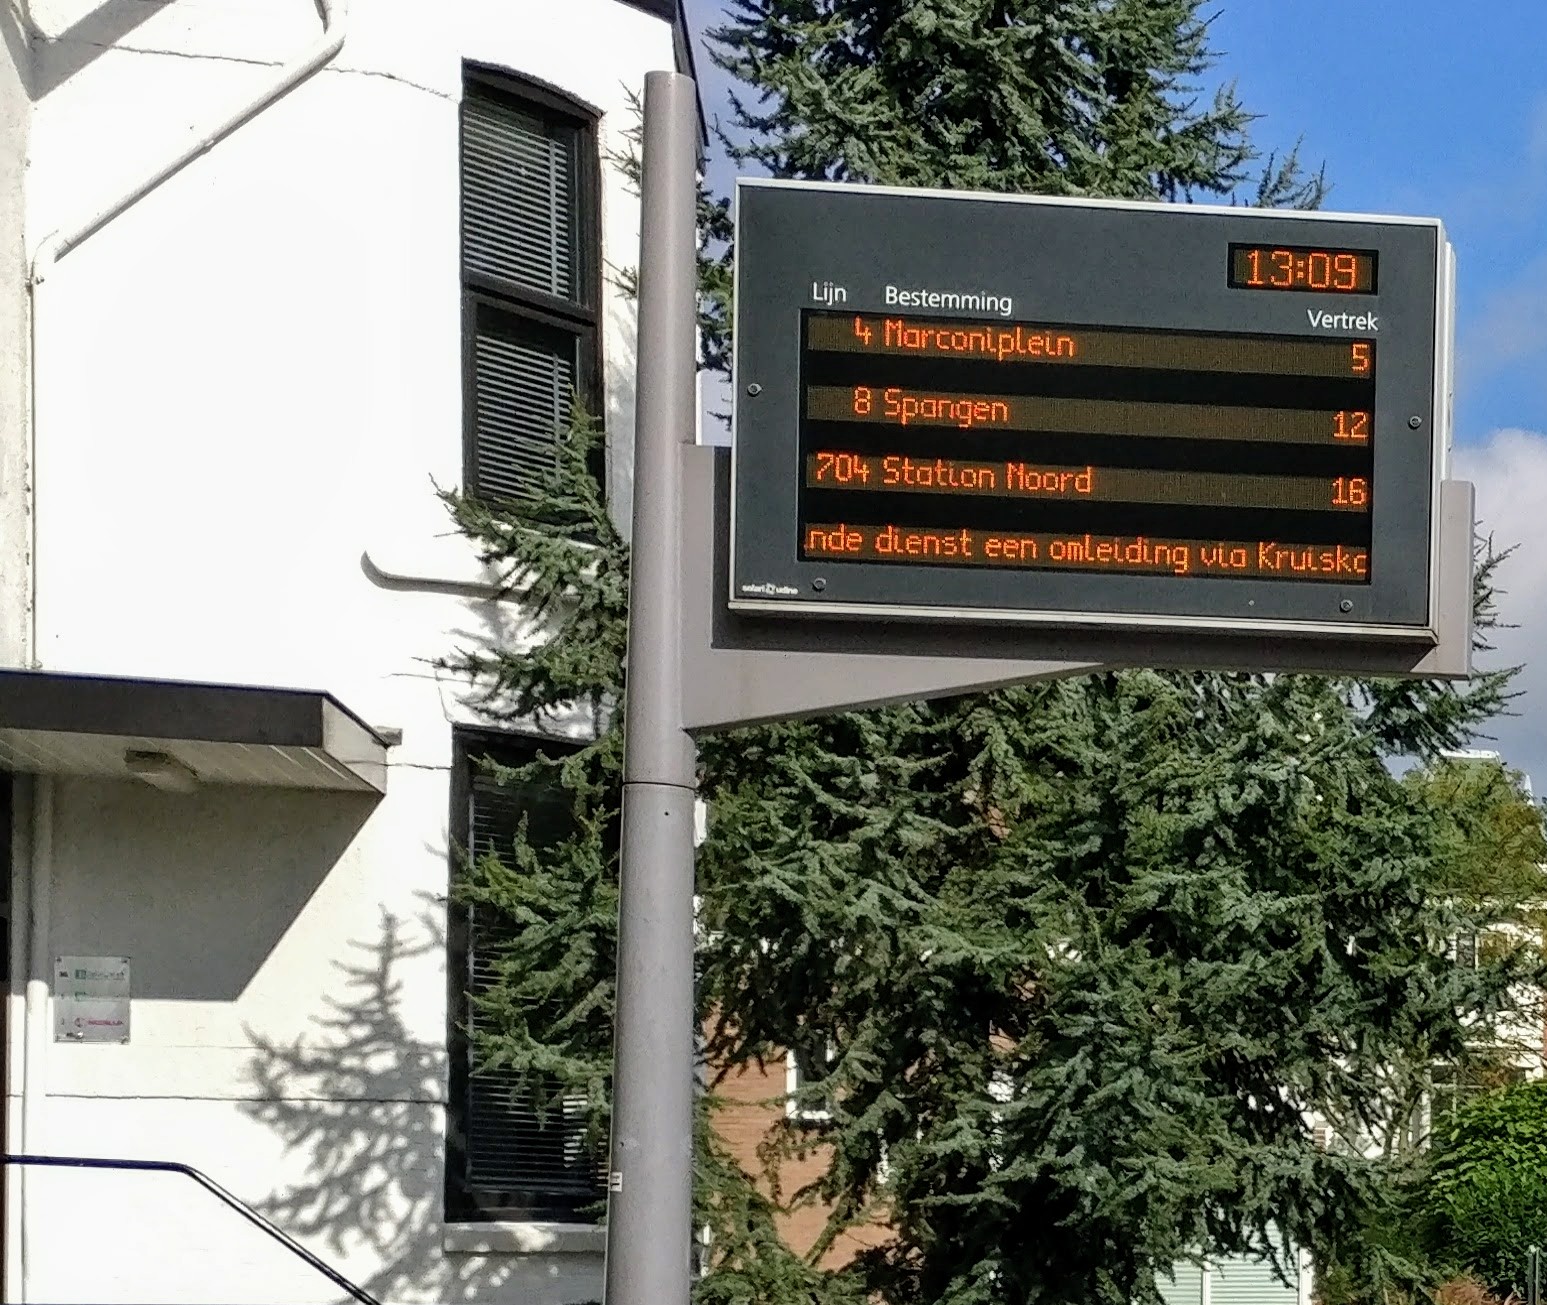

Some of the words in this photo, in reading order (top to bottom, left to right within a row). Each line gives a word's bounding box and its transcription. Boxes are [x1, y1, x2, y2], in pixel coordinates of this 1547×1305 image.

[1247, 249, 1358, 290] 13:09
[813, 282, 847, 305] Lijn
[885, 285, 1013, 314] Bestemming
[1308, 309, 1379, 331] Vertrek
[854, 317, 872, 346] 4
[884, 319, 1076, 362] Marconiplein
[1351, 343, 1369, 371] 5
[854, 386, 872, 414] 8
[884, 388, 1008, 428] Spangen
[1333, 411, 1368, 440] 12
[816, 452, 870, 485] 704
[882, 456, 995, 489] Station
[1006, 462, 1093, 494] Noord
[1332, 477, 1367, 506] 16
[874, 525, 973, 557] dienst
[984, 537, 1037, 562] een
[1049, 535, 1190, 574] omleiding
[1200, 541, 1248, 569] via
